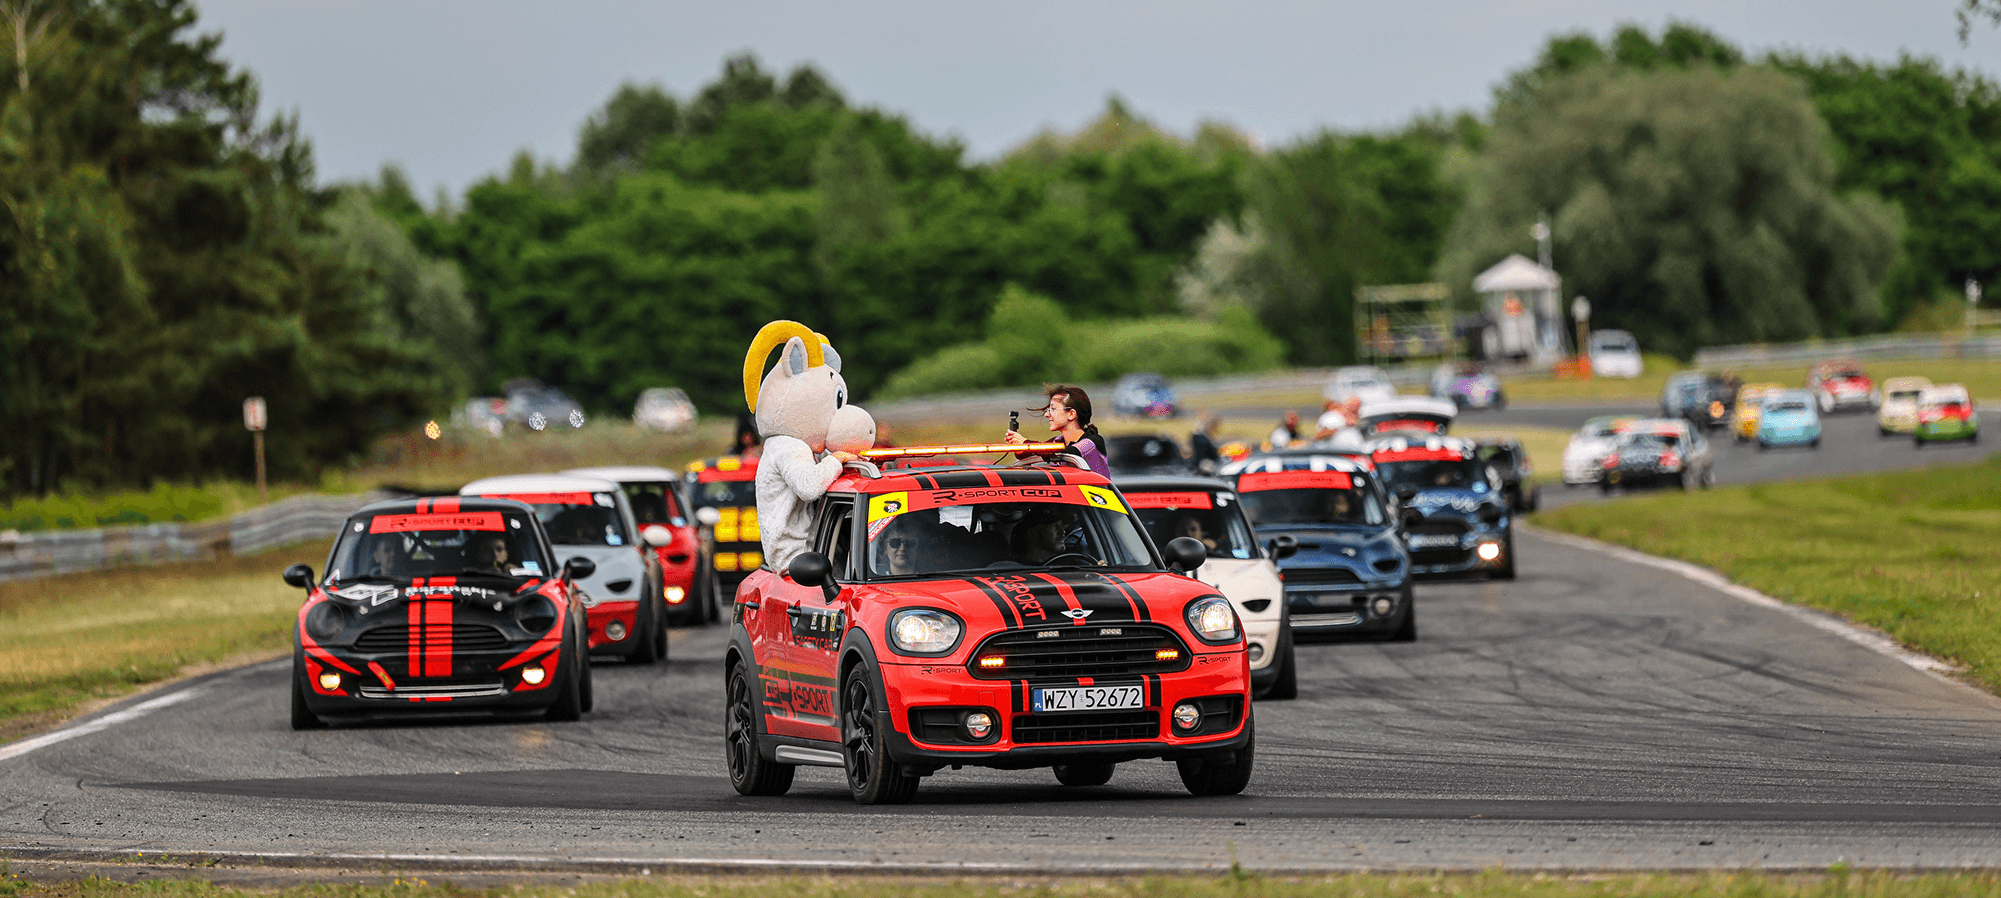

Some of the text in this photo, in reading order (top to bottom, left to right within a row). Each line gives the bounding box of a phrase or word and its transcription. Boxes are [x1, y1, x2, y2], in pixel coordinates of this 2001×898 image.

[1020, 488, 1062, 499] CUP
[1043, 687, 1141, 710] WZY 52672
